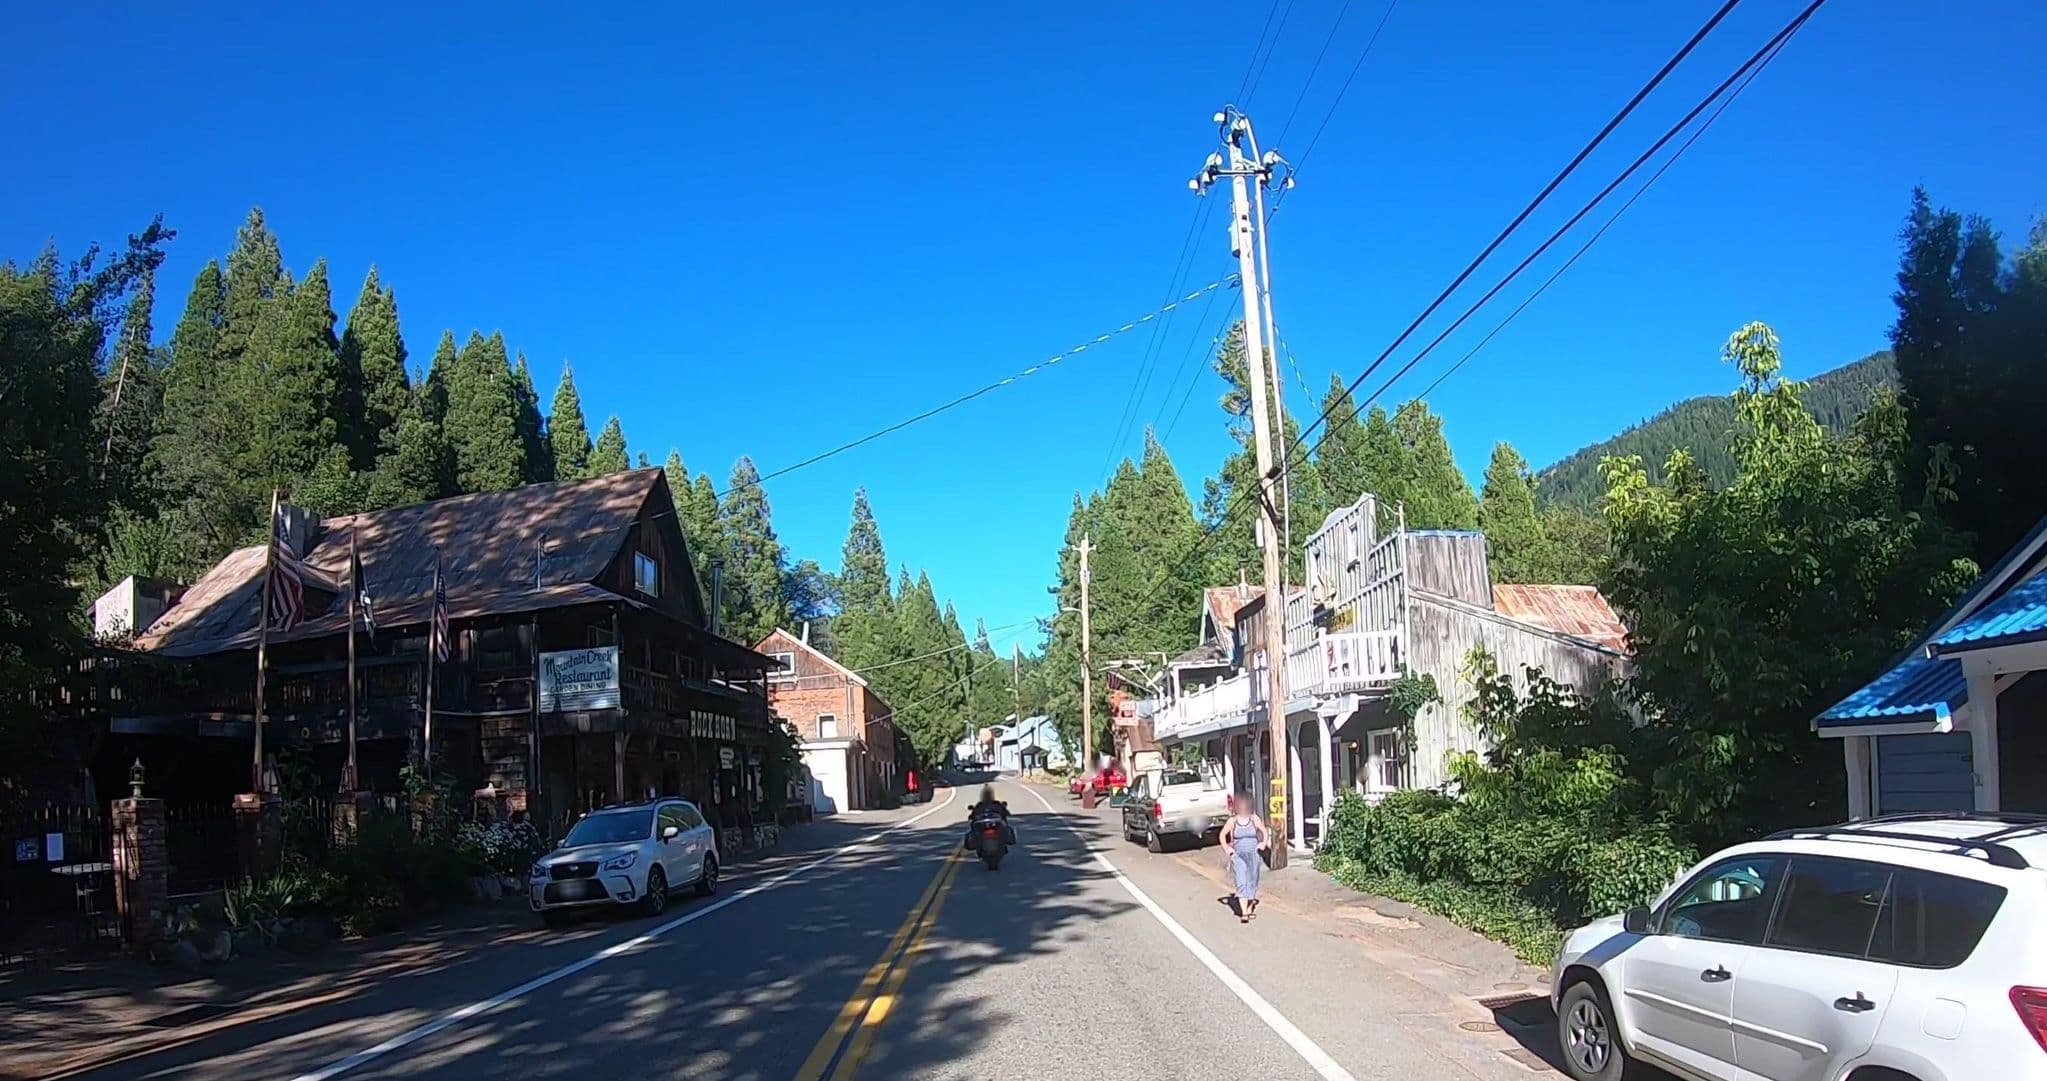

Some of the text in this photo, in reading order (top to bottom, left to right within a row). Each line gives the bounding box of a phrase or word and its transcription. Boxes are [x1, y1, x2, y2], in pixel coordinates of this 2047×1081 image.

[543, 650, 612, 676] Mountain Creek
[555, 667, 612, 685] Restaurant
